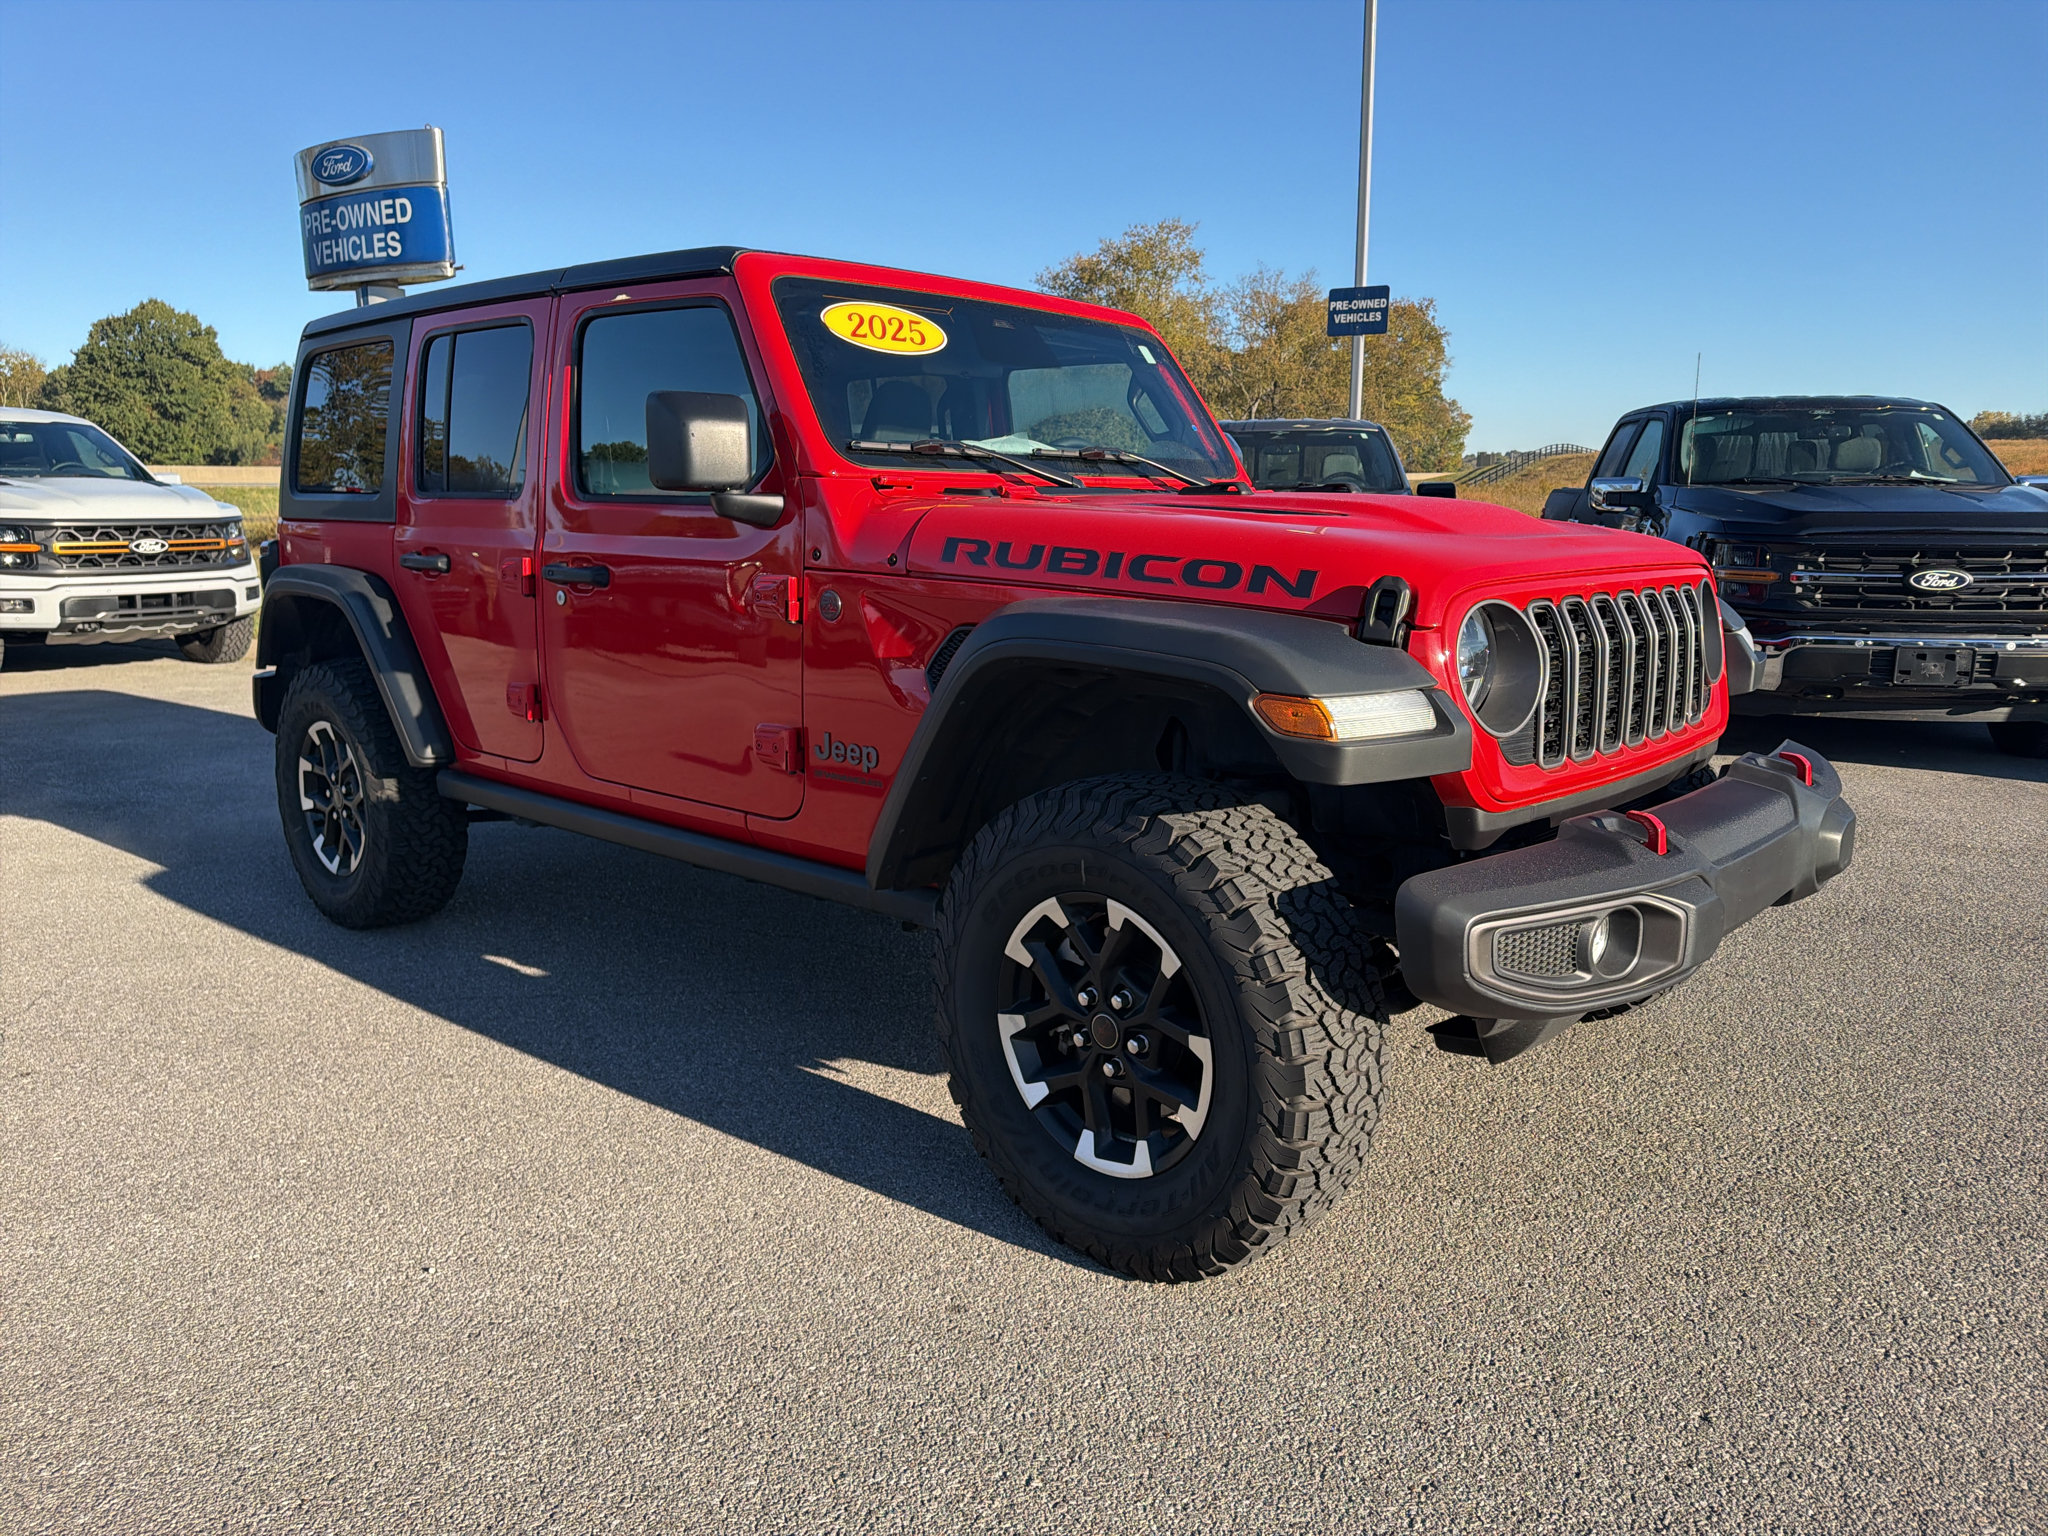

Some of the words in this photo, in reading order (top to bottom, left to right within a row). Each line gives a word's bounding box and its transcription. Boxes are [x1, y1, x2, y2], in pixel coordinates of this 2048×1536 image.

[321, 153, 353, 177] Ford
[304, 197, 413, 237] PRE-OWNED
[313, 230, 402, 266] VEHICLES
[1329, 298, 1387, 311] PRE-OWNED
[1333, 311, 1382, 324] VEHICLES
[847, 312, 926, 346] 2025
[939, 536, 1321, 599] RUBICON
[1920, 572, 1959, 587] Ford
[814, 731, 880, 774] Jeep
